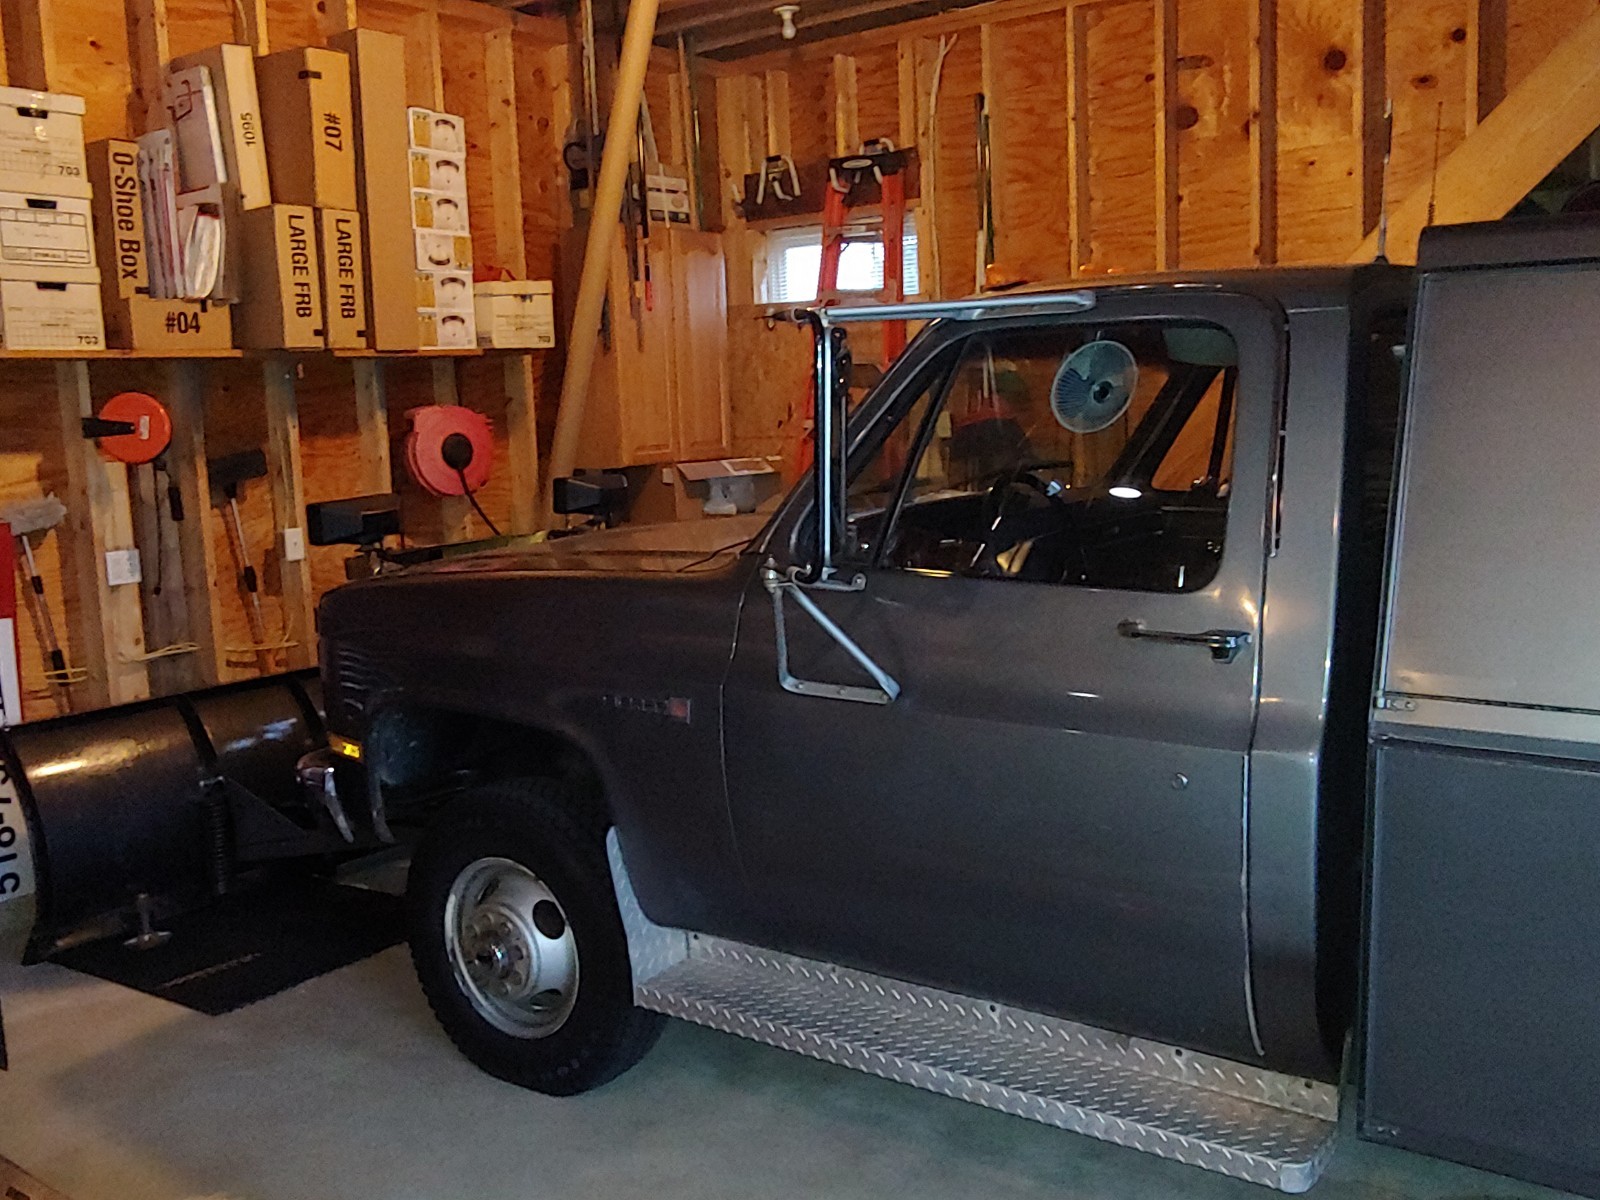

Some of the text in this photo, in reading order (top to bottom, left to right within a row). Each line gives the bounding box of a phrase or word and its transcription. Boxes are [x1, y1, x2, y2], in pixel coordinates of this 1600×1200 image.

[240, 112, 256, 147] 1095
[323, 112, 343, 152] #07
[119, 239, 141, 279] Box
[288, 214, 312, 318] LARGE FRB
[335, 218, 356, 319] LARGE FRB
[165, 311, 200, 334] #04
